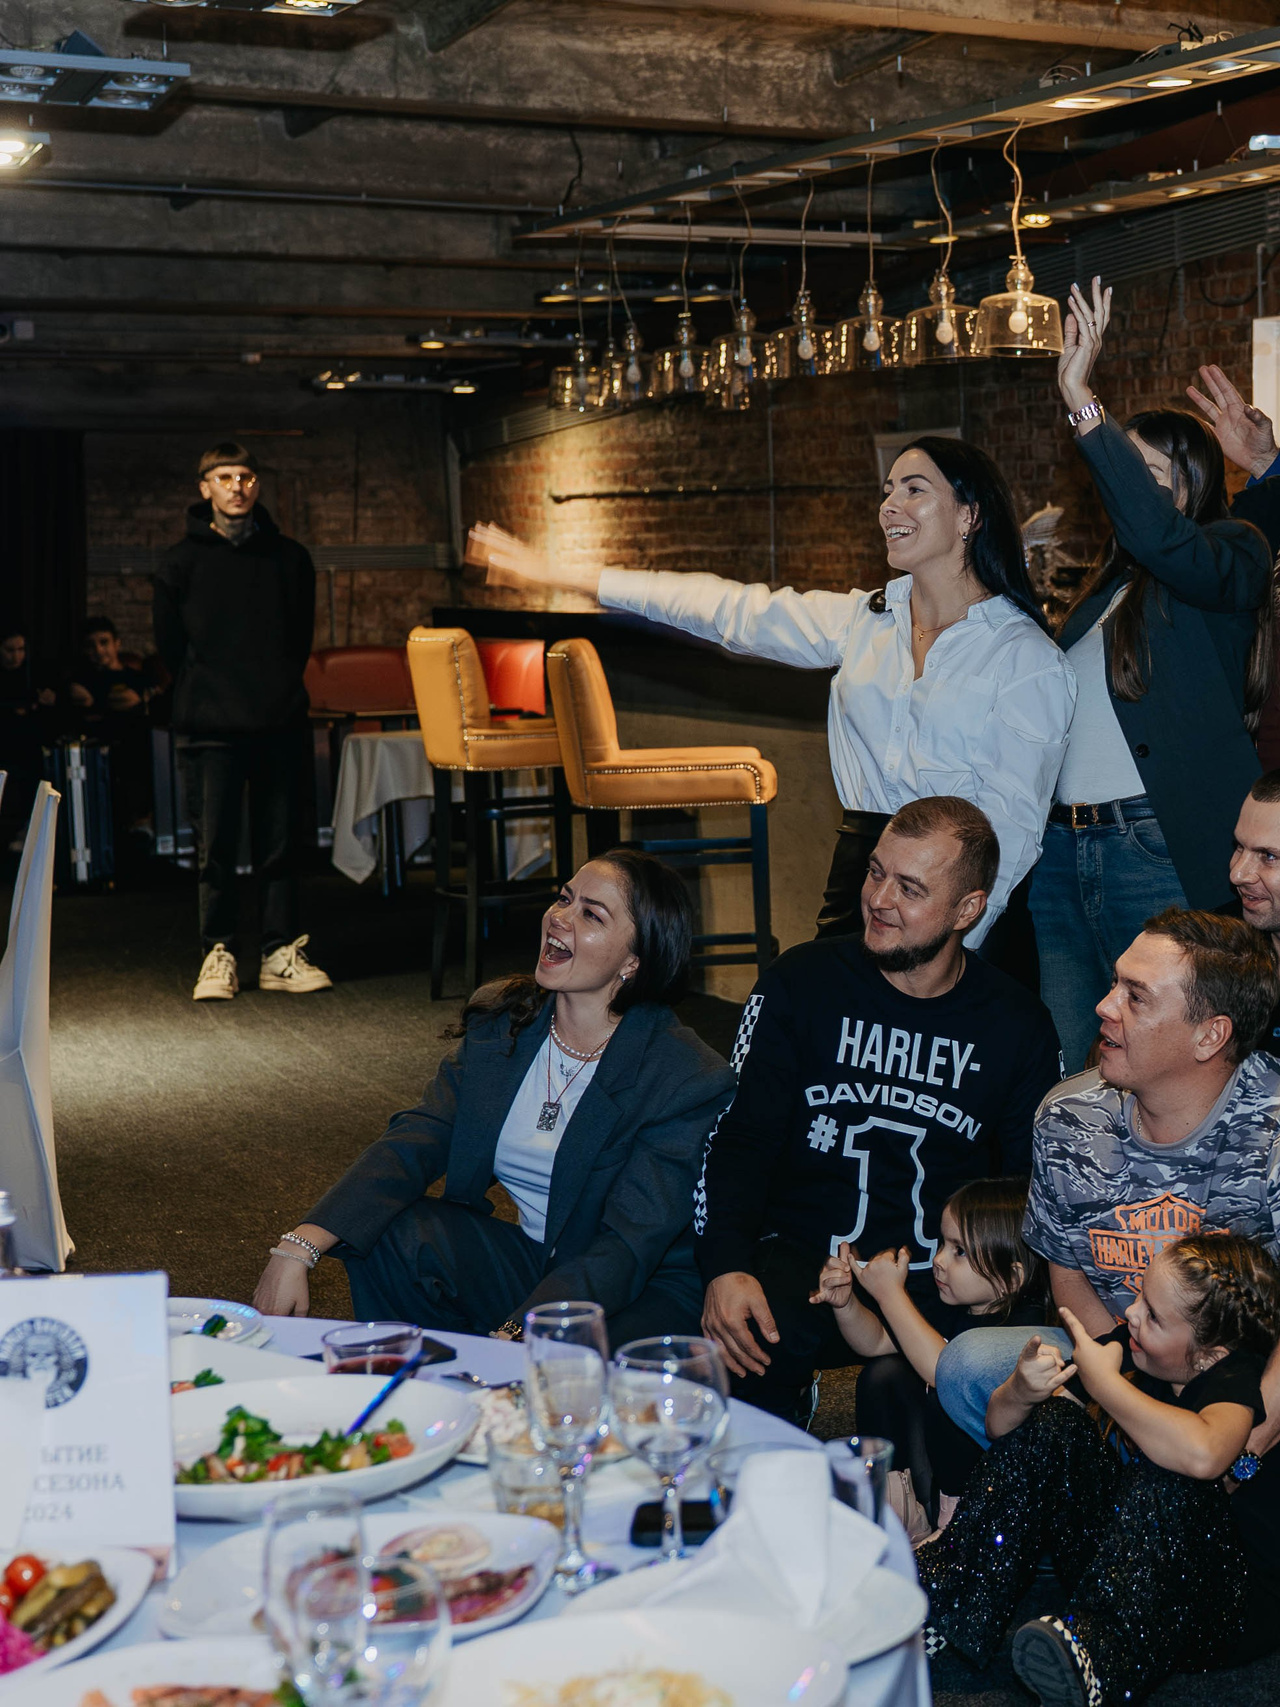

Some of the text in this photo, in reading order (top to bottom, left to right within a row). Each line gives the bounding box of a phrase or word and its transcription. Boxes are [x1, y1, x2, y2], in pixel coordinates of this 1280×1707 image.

[836, 1017, 981, 1089] HARLEY-
[805, 1082, 982, 1141] DAVIDSON
[806, 1113, 938, 1270] #1
[1129, 1200, 1200, 1233] MOTOR
[33, 1470, 127, 1493] СЕЗОНА
